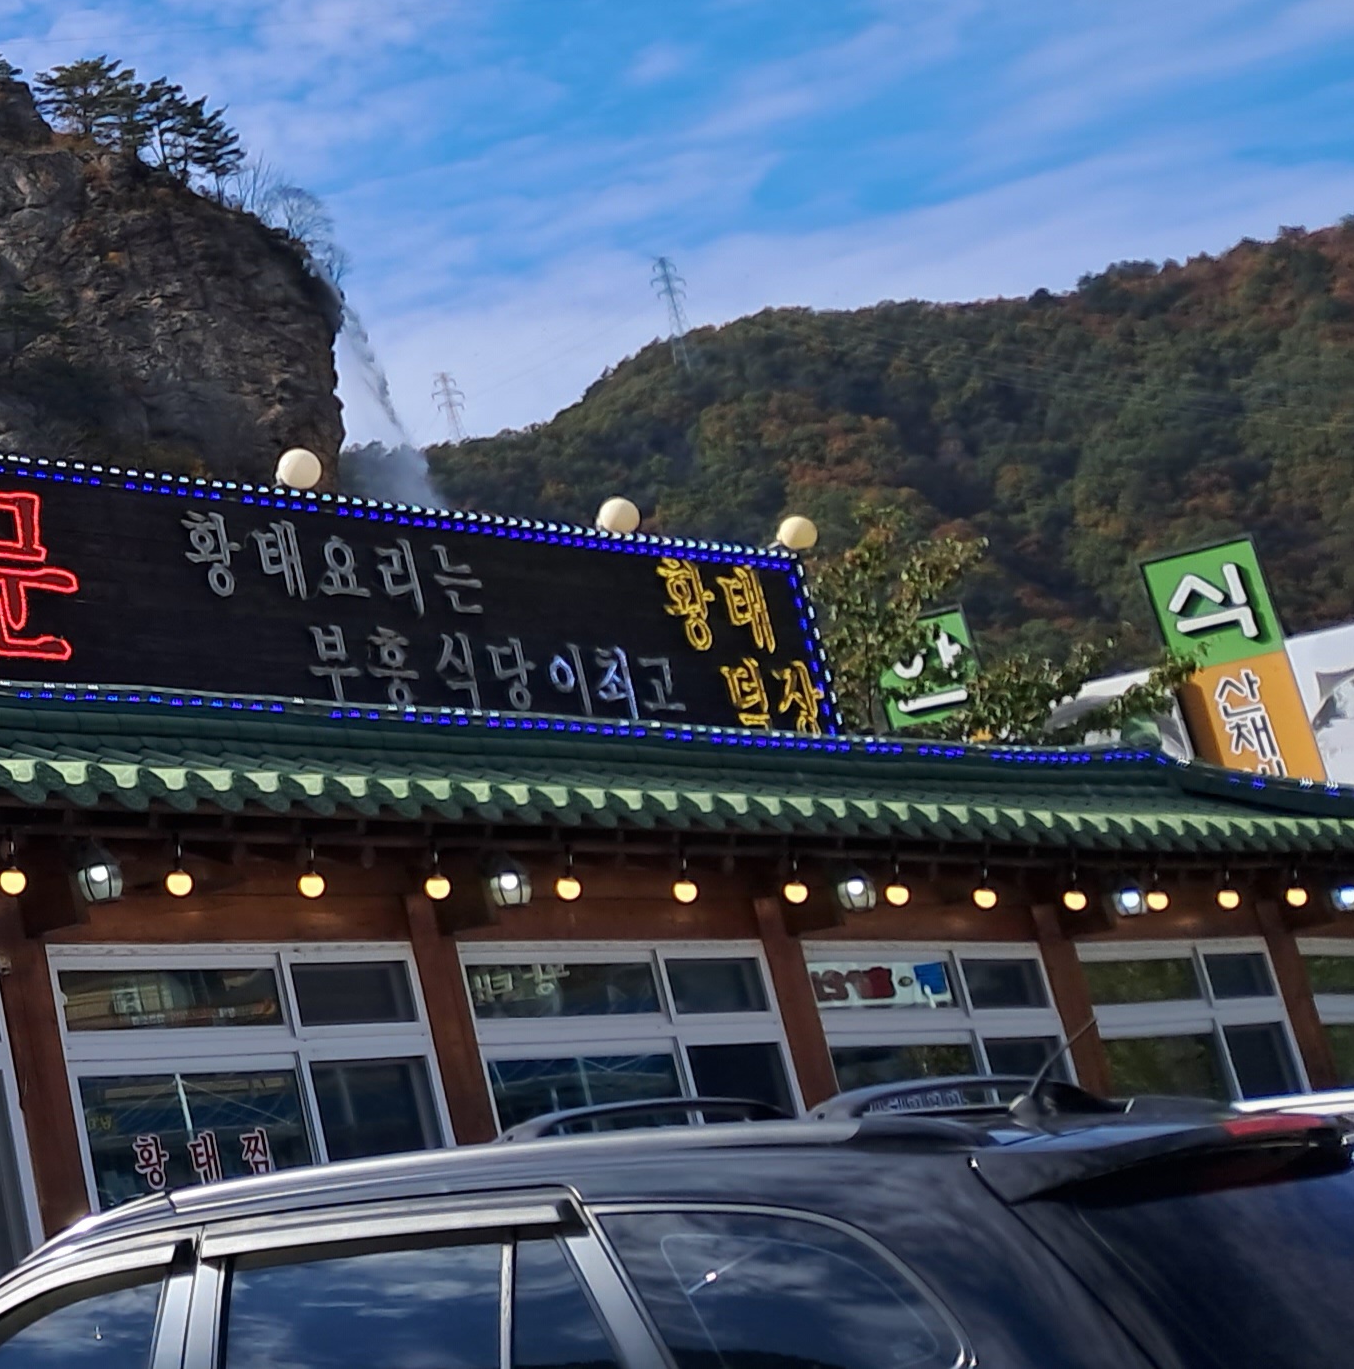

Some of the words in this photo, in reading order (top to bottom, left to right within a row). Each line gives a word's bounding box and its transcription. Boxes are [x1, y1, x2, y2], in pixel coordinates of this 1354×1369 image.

[656, 556, 776, 654] 황태
[1168, 562, 1260, 640] 식
[131, 1127, 272, 1191] 황태찜
